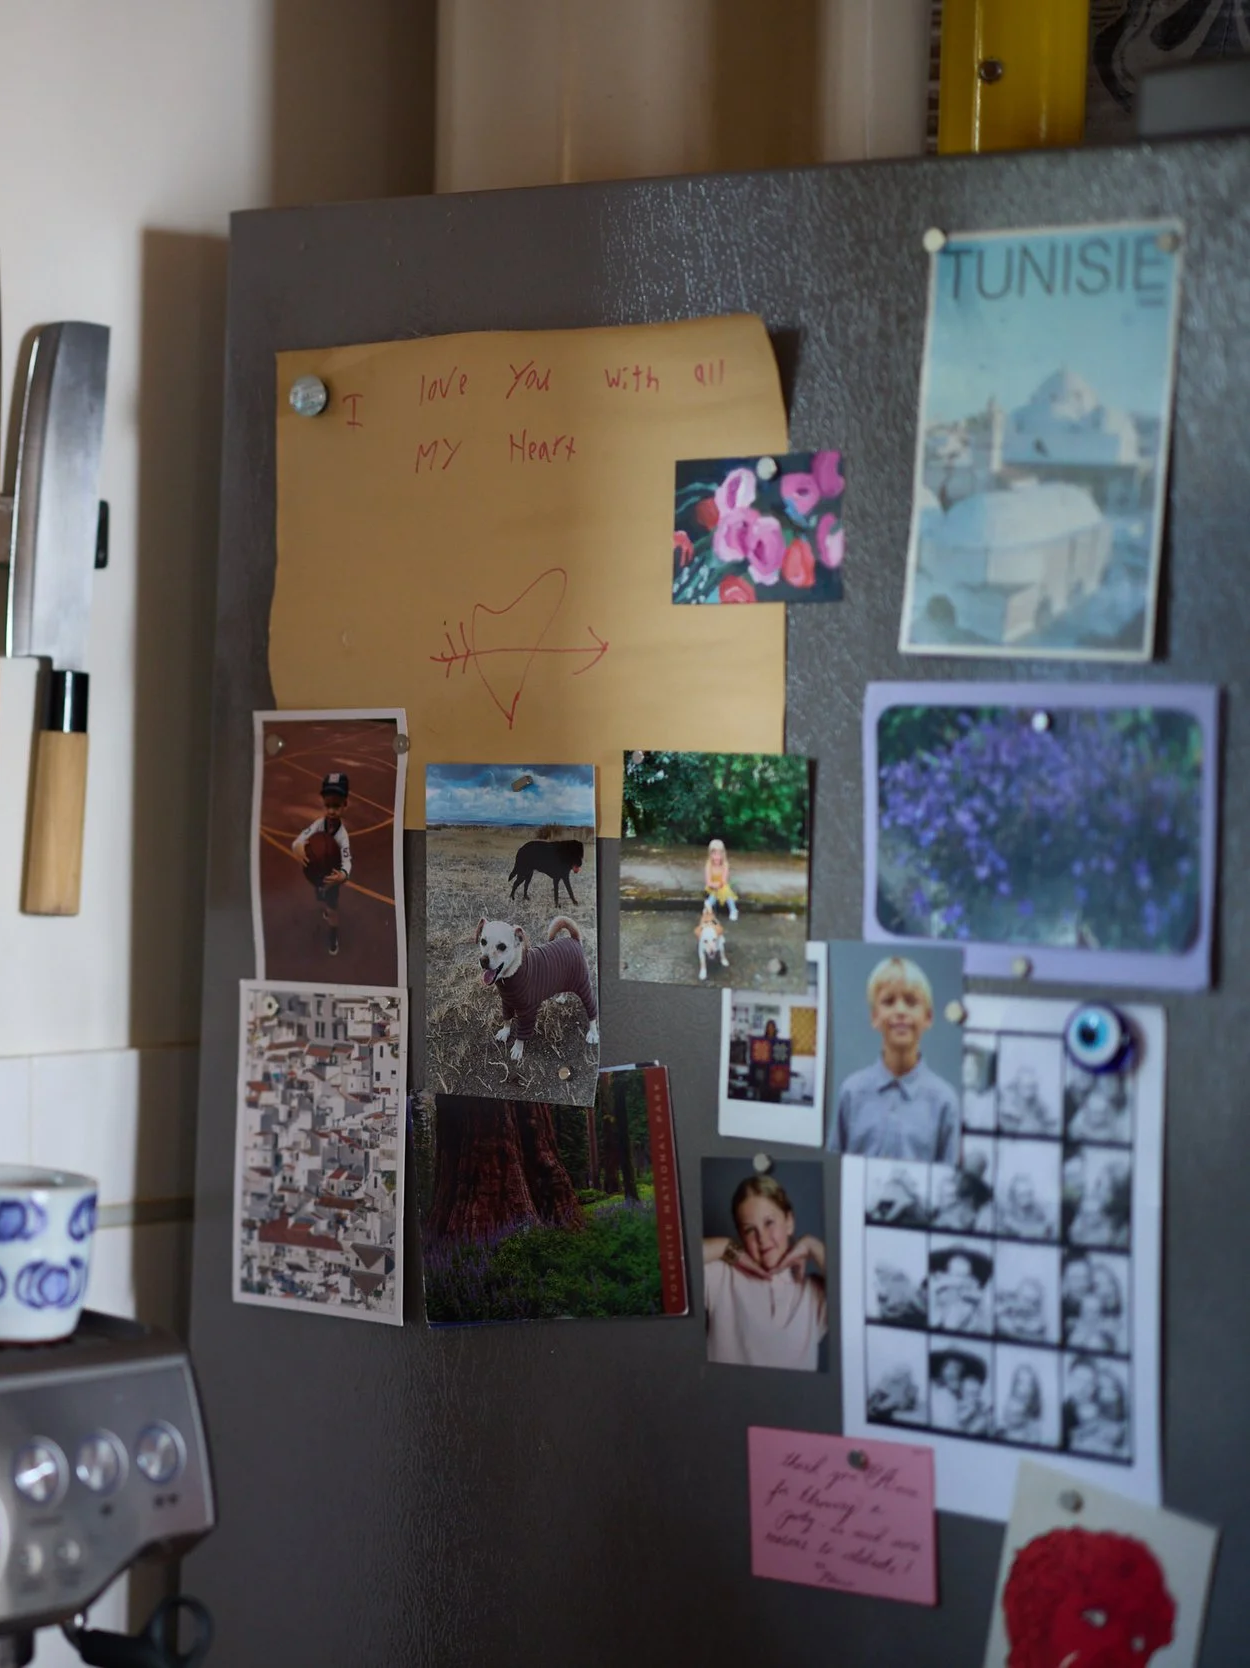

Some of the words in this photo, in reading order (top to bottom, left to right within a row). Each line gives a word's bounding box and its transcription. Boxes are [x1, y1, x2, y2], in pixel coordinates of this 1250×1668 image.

[940, 235, 1166, 300] TUNISIE
[343, 393, 364, 427] I
[418, 365, 468, 406] love
[693, 358, 726, 387] all
[509, 428, 577, 464] Heart
[653, 1082, 663, 1122] PARK
[658, 1133, 671, 1213] NATIONAL
[664, 1224, 678, 1302] YOSEMITE
